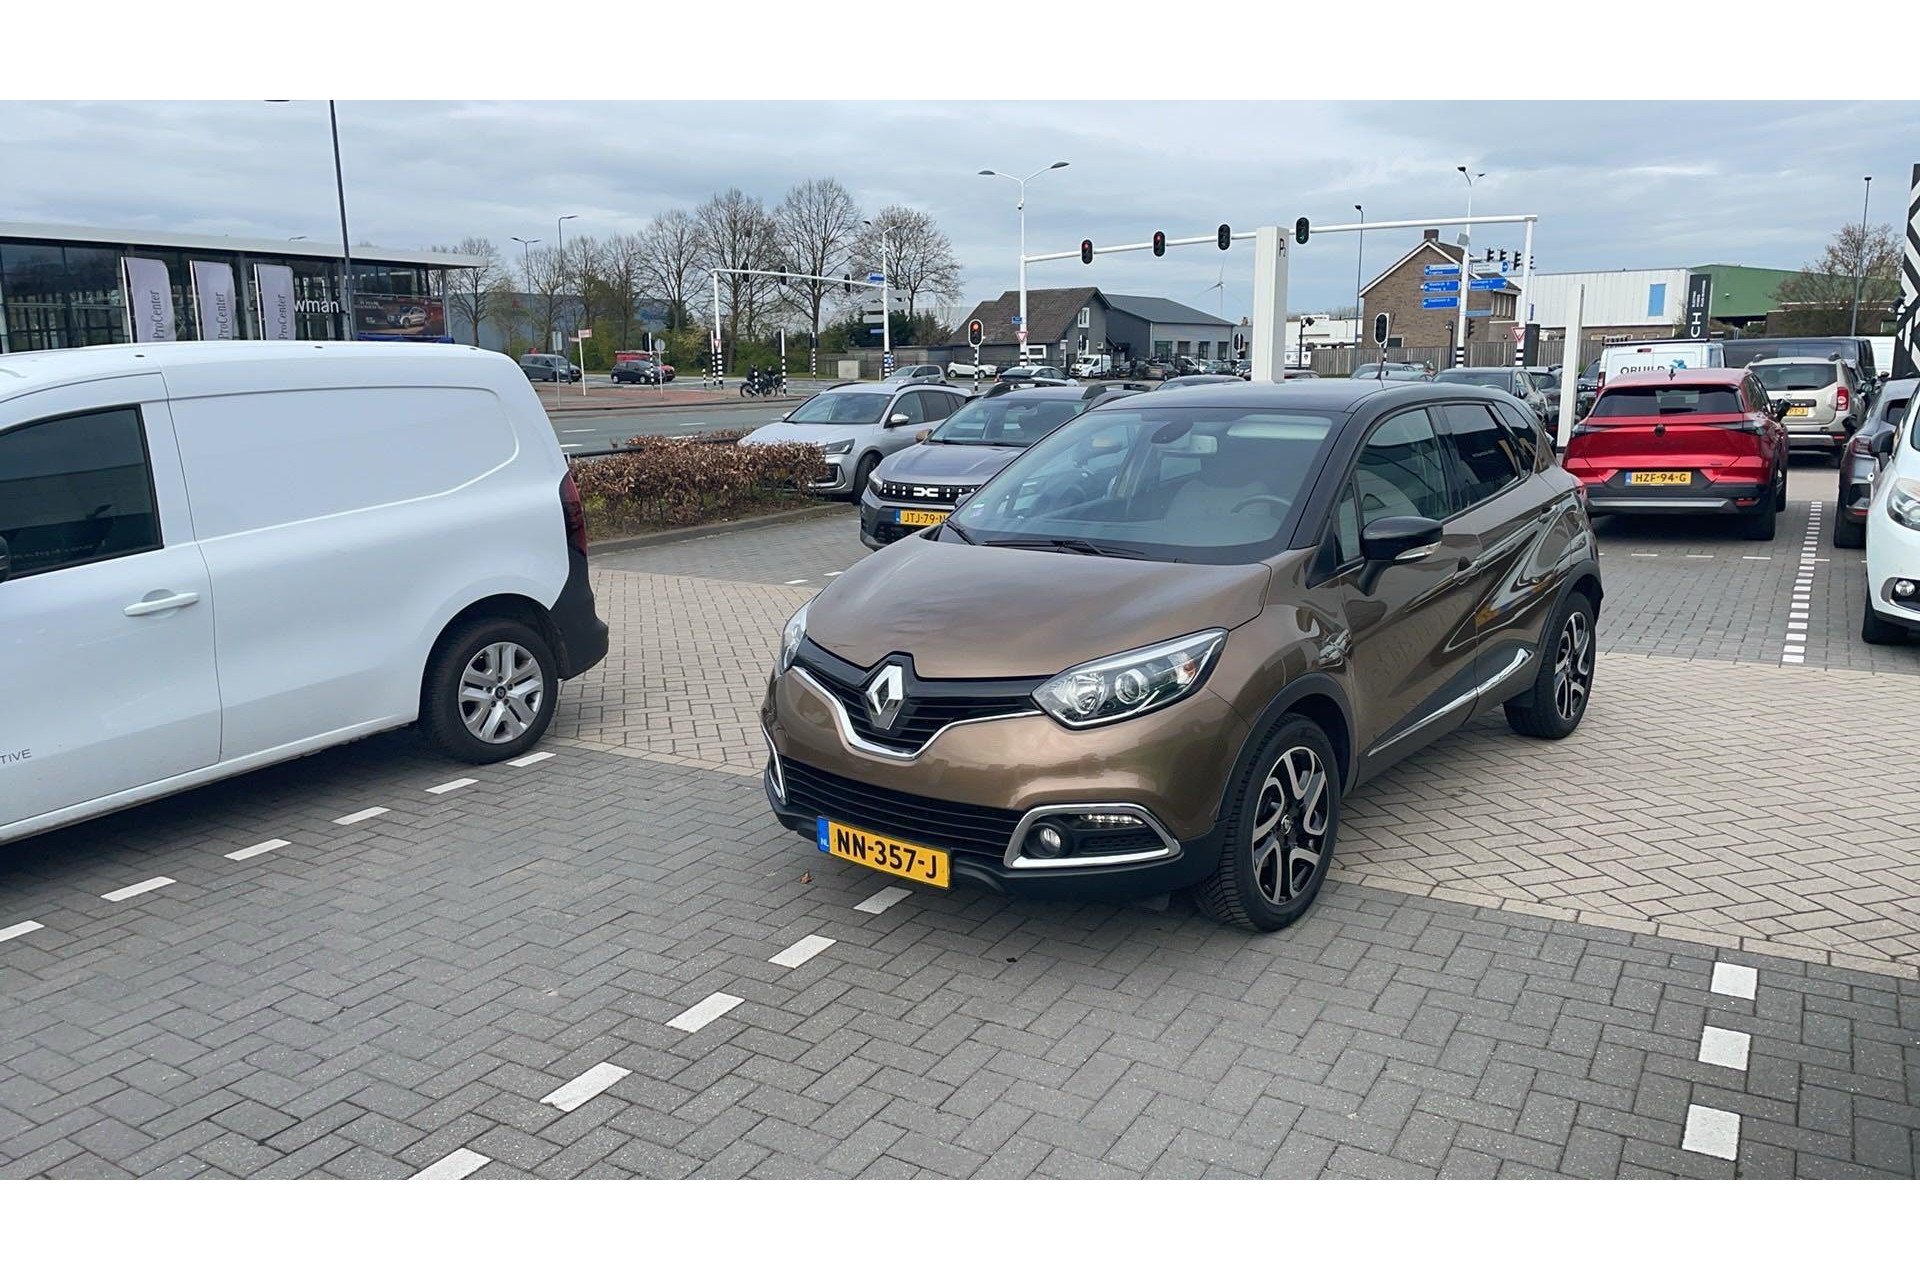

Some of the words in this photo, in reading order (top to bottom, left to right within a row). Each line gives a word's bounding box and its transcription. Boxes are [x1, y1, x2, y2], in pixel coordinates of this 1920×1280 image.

[150, 290, 165, 339] ProCenter
[215, 292, 229, 340] ProCenter
[278, 294, 288, 340] ProCenter
[1635, 473, 1687, 483] HZF-94-G
[904, 511, 947, 523] JTJ-79-N
[0, 748, 32, 764] TIVE
[836, 828, 938, 880] NN-357-J
